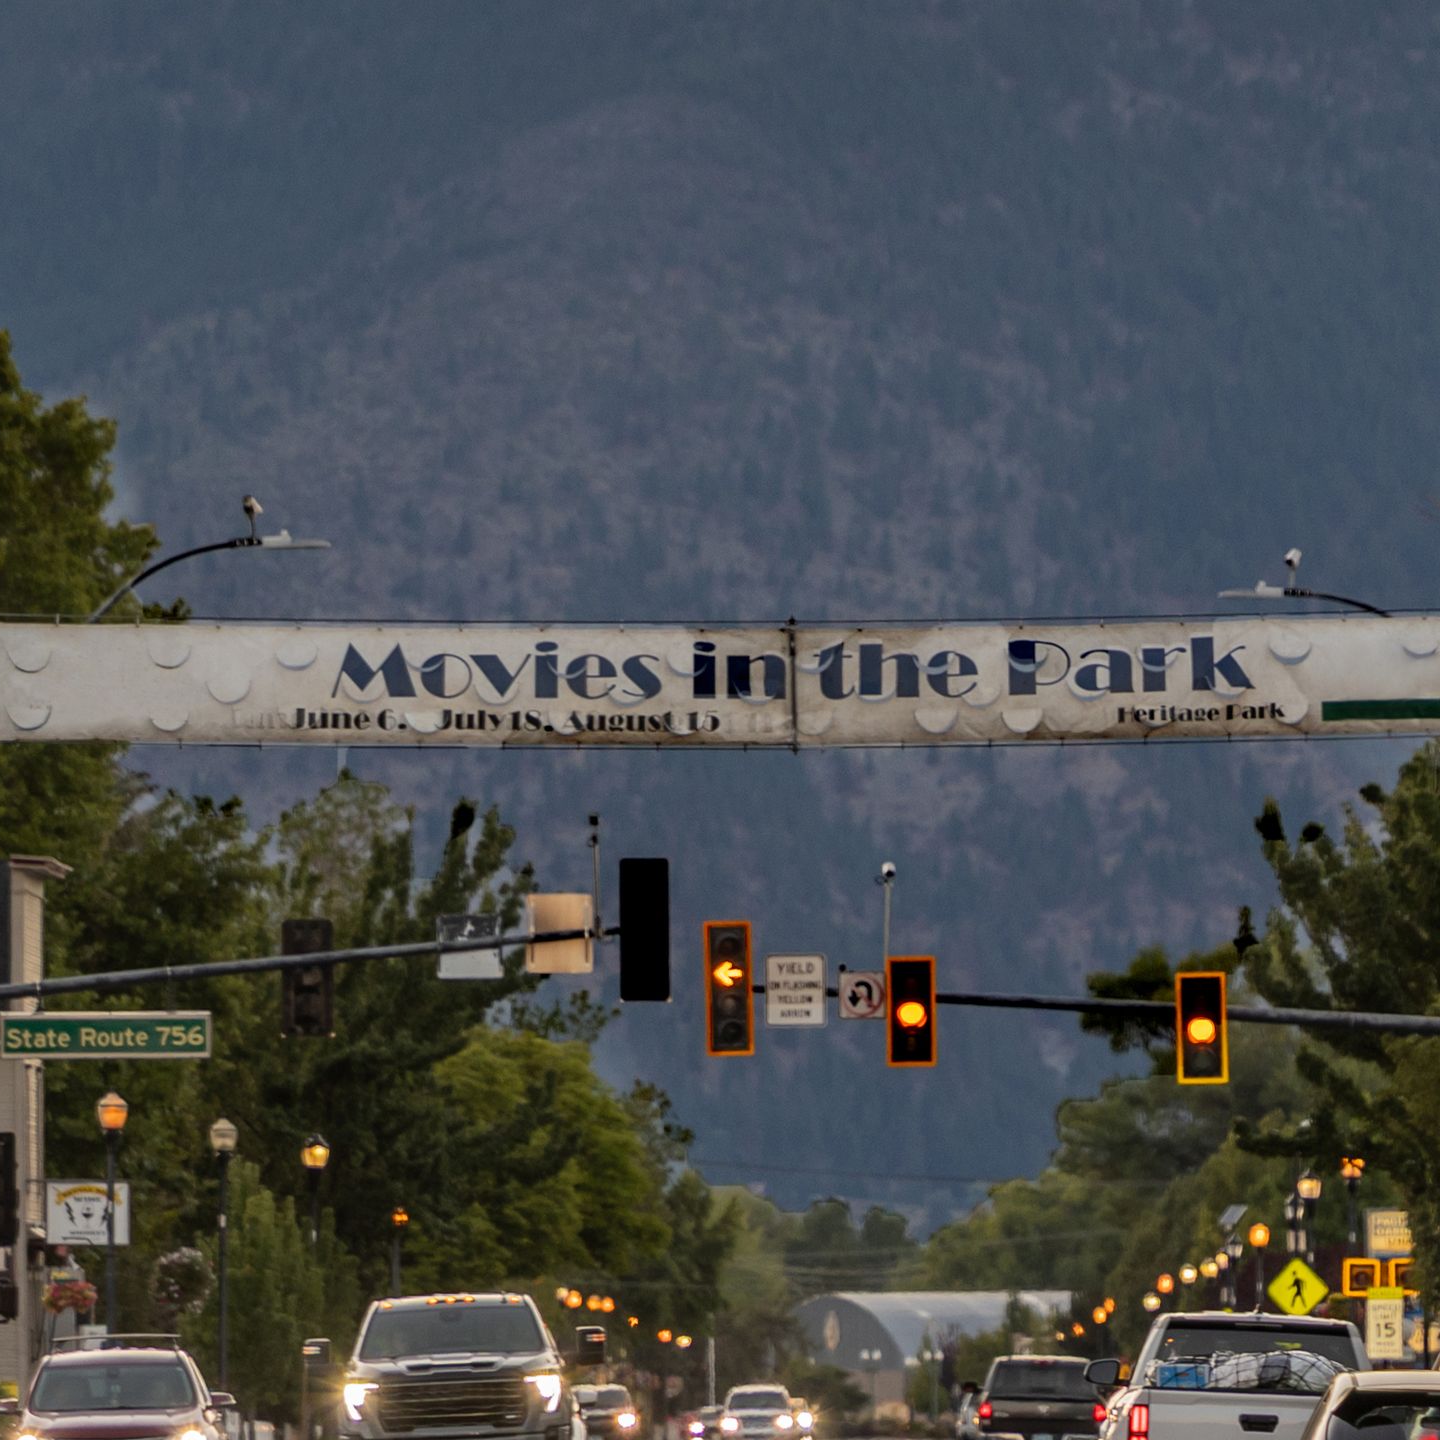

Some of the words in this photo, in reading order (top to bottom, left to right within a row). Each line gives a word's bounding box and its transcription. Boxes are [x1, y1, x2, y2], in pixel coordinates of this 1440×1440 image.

[331, 641, 662, 699] Movies
[693, 641, 786, 699] in
[814, 642, 978, 699] the
[1008, 636, 1256, 695] Park
[291, 708, 371, 731] June
[563, 710, 673, 734] August
[687, 710, 721, 732] 15
[1117, 703, 1220, 723] Heritage
[1226, 702, 1286, 721] Park
[777, 962, 815, 975] YIELD
[7, 1028, 71, 1049] State
[80, 1027, 149, 1048] Route
[156, 1025, 205, 1047] 756
[1376, 1322, 1396, 1338] 15
